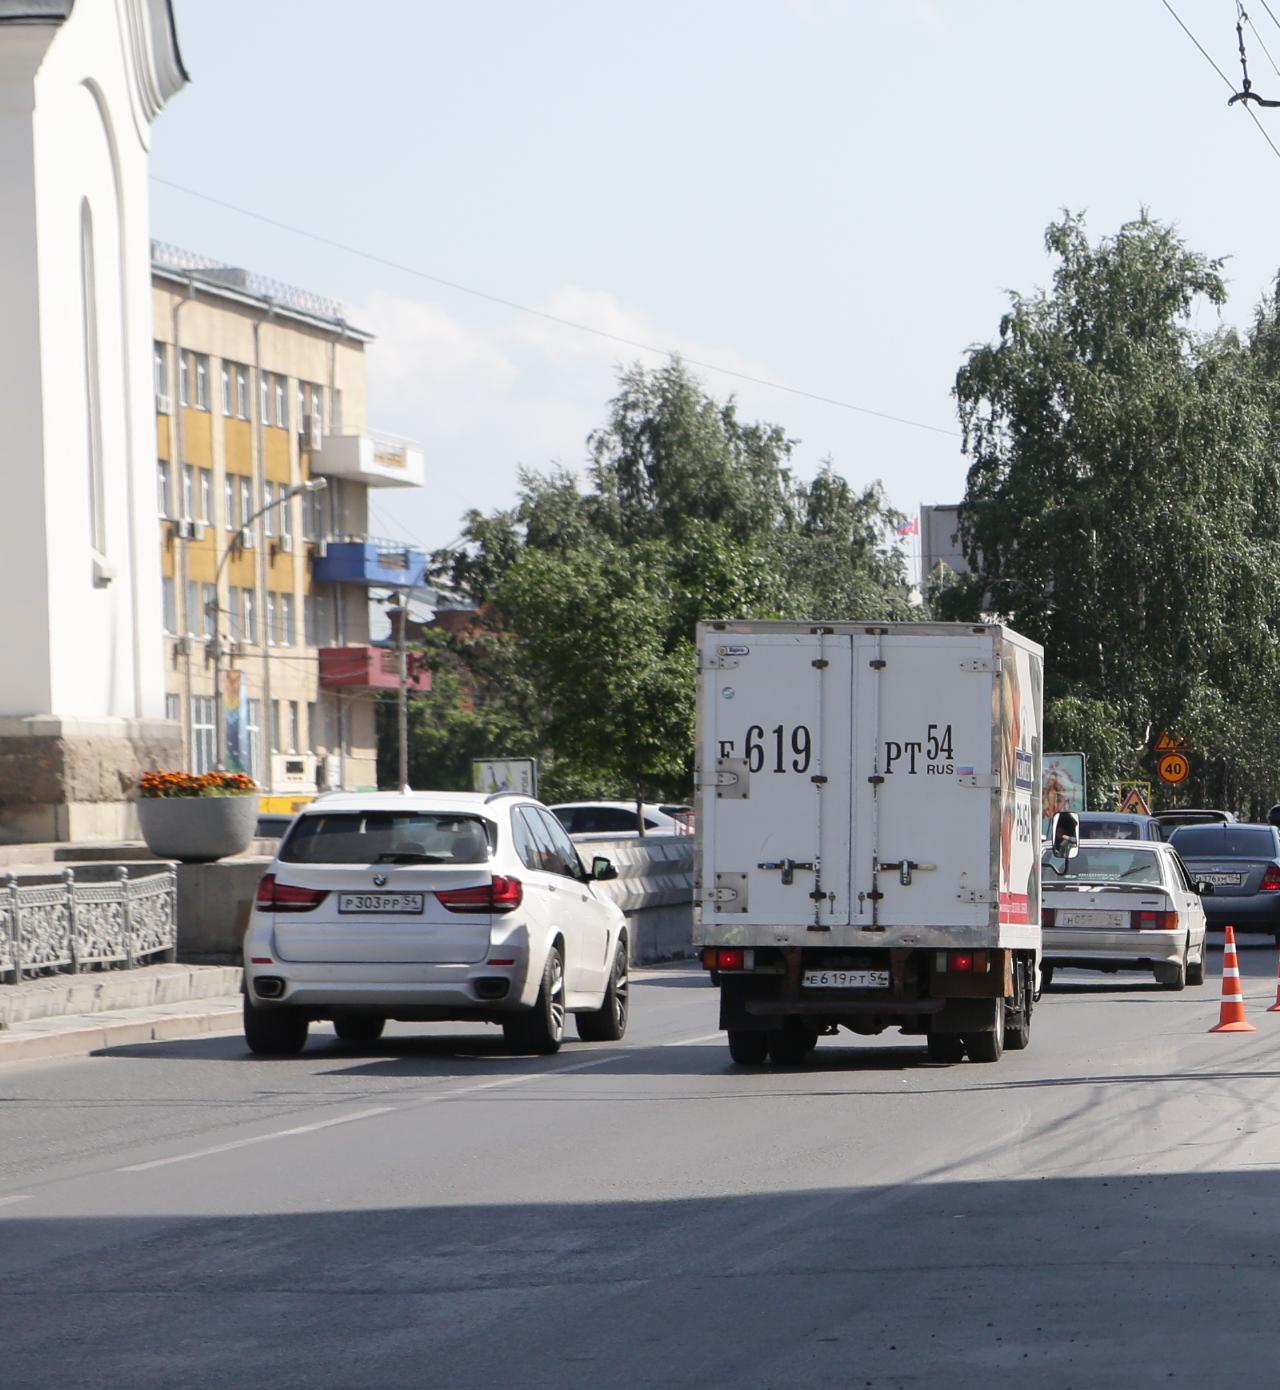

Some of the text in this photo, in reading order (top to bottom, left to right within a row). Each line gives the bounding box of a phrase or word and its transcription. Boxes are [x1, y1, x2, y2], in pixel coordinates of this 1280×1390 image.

[926, 724, 954, 760] 54
[926, 764, 954, 775] RUS
[1165, 763, 1181, 775] 40
